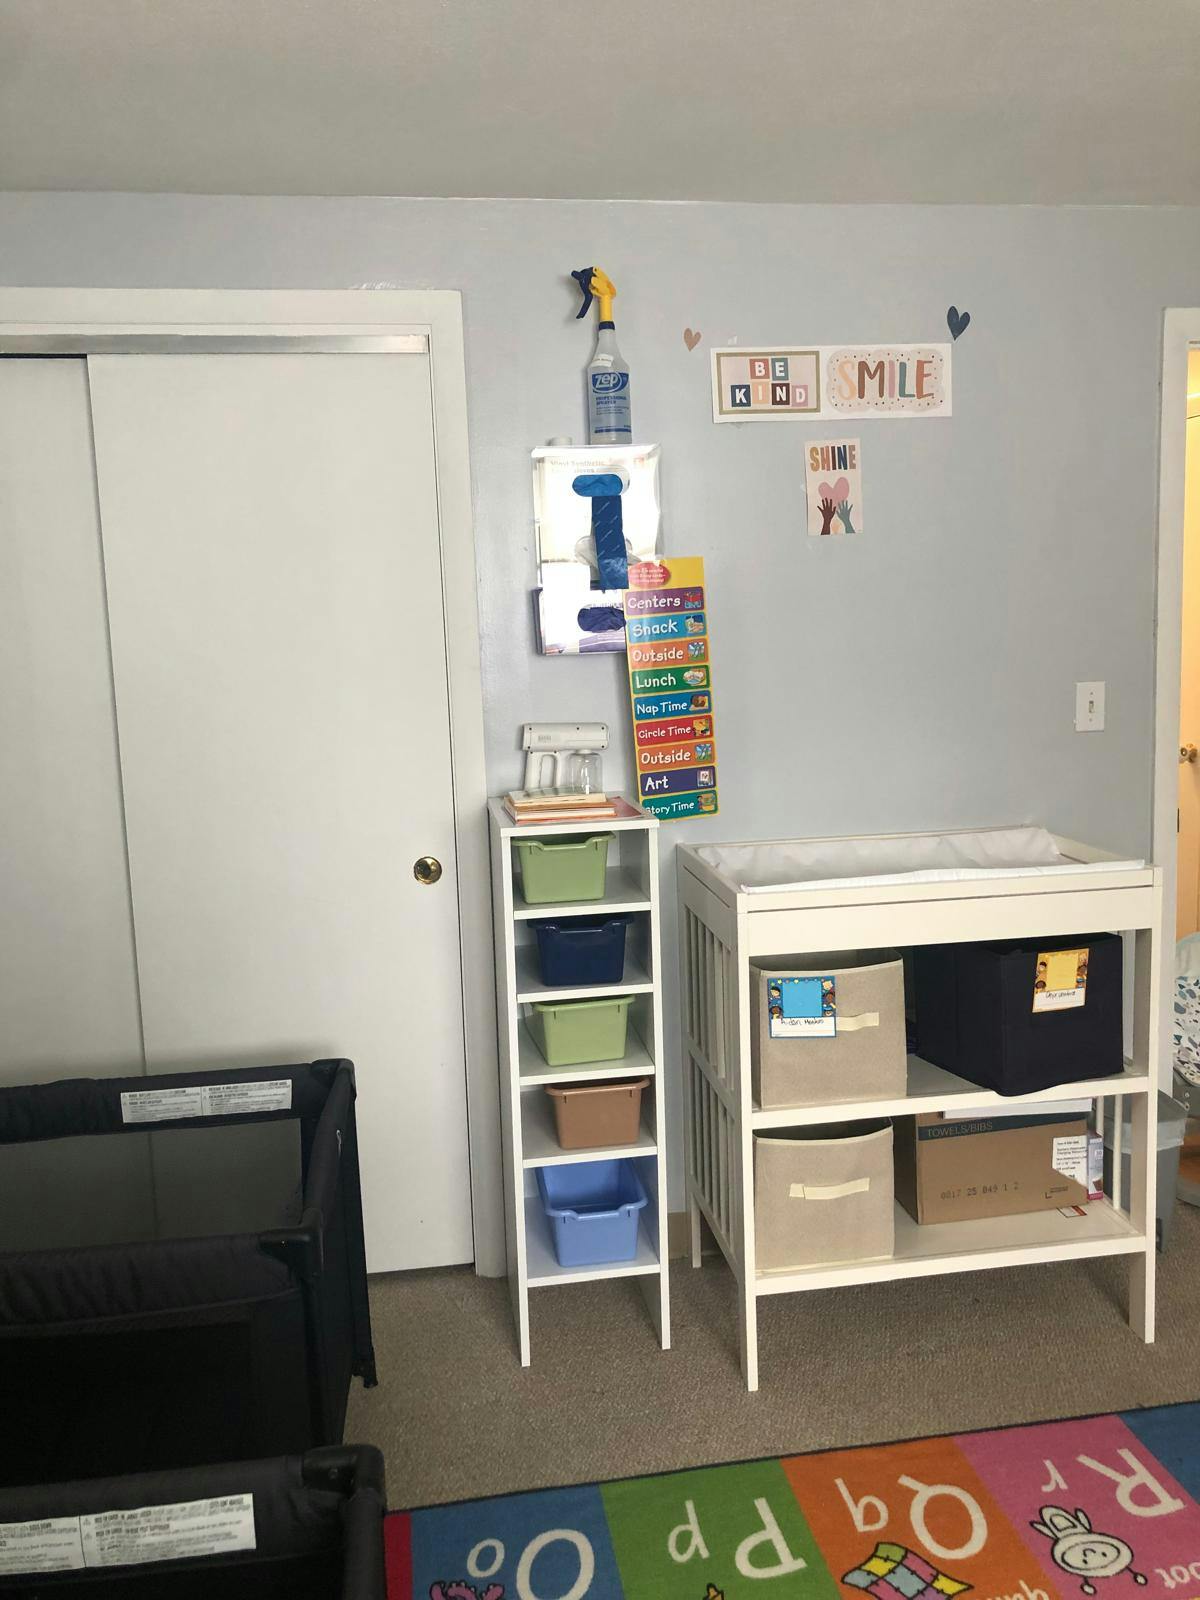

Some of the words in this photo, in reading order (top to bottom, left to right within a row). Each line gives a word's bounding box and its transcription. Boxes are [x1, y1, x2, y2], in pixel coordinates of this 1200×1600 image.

[754, 360, 786, 378] BE
[837, 359, 935, 401] SMILE
[734, 385, 806, 405] KIND
[809, 444, 857, 472] SHINE
[627, 595, 681, 609] Centers
[632, 619, 678, 637] Snack
[632, 647, 684, 662] Outside
[635, 673, 677, 689] Lunch
[636, 704, 659, 715] Nap
[660, 701, 688, 713] Time
[638, 727, 666, 739] Circle
[667, 725, 692, 737] Time
[641, 749, 691, 765] Outside
[645, 775, 669, 791] Art
[671, 801, 695, 813] Time
[927, 1121, 993, 1138] TOWELS/BIBS
[1076, 1448, 1185, 1518] R
[897, 1474, 988, 1560] Q
[735, 1497, 808, 1580] P
